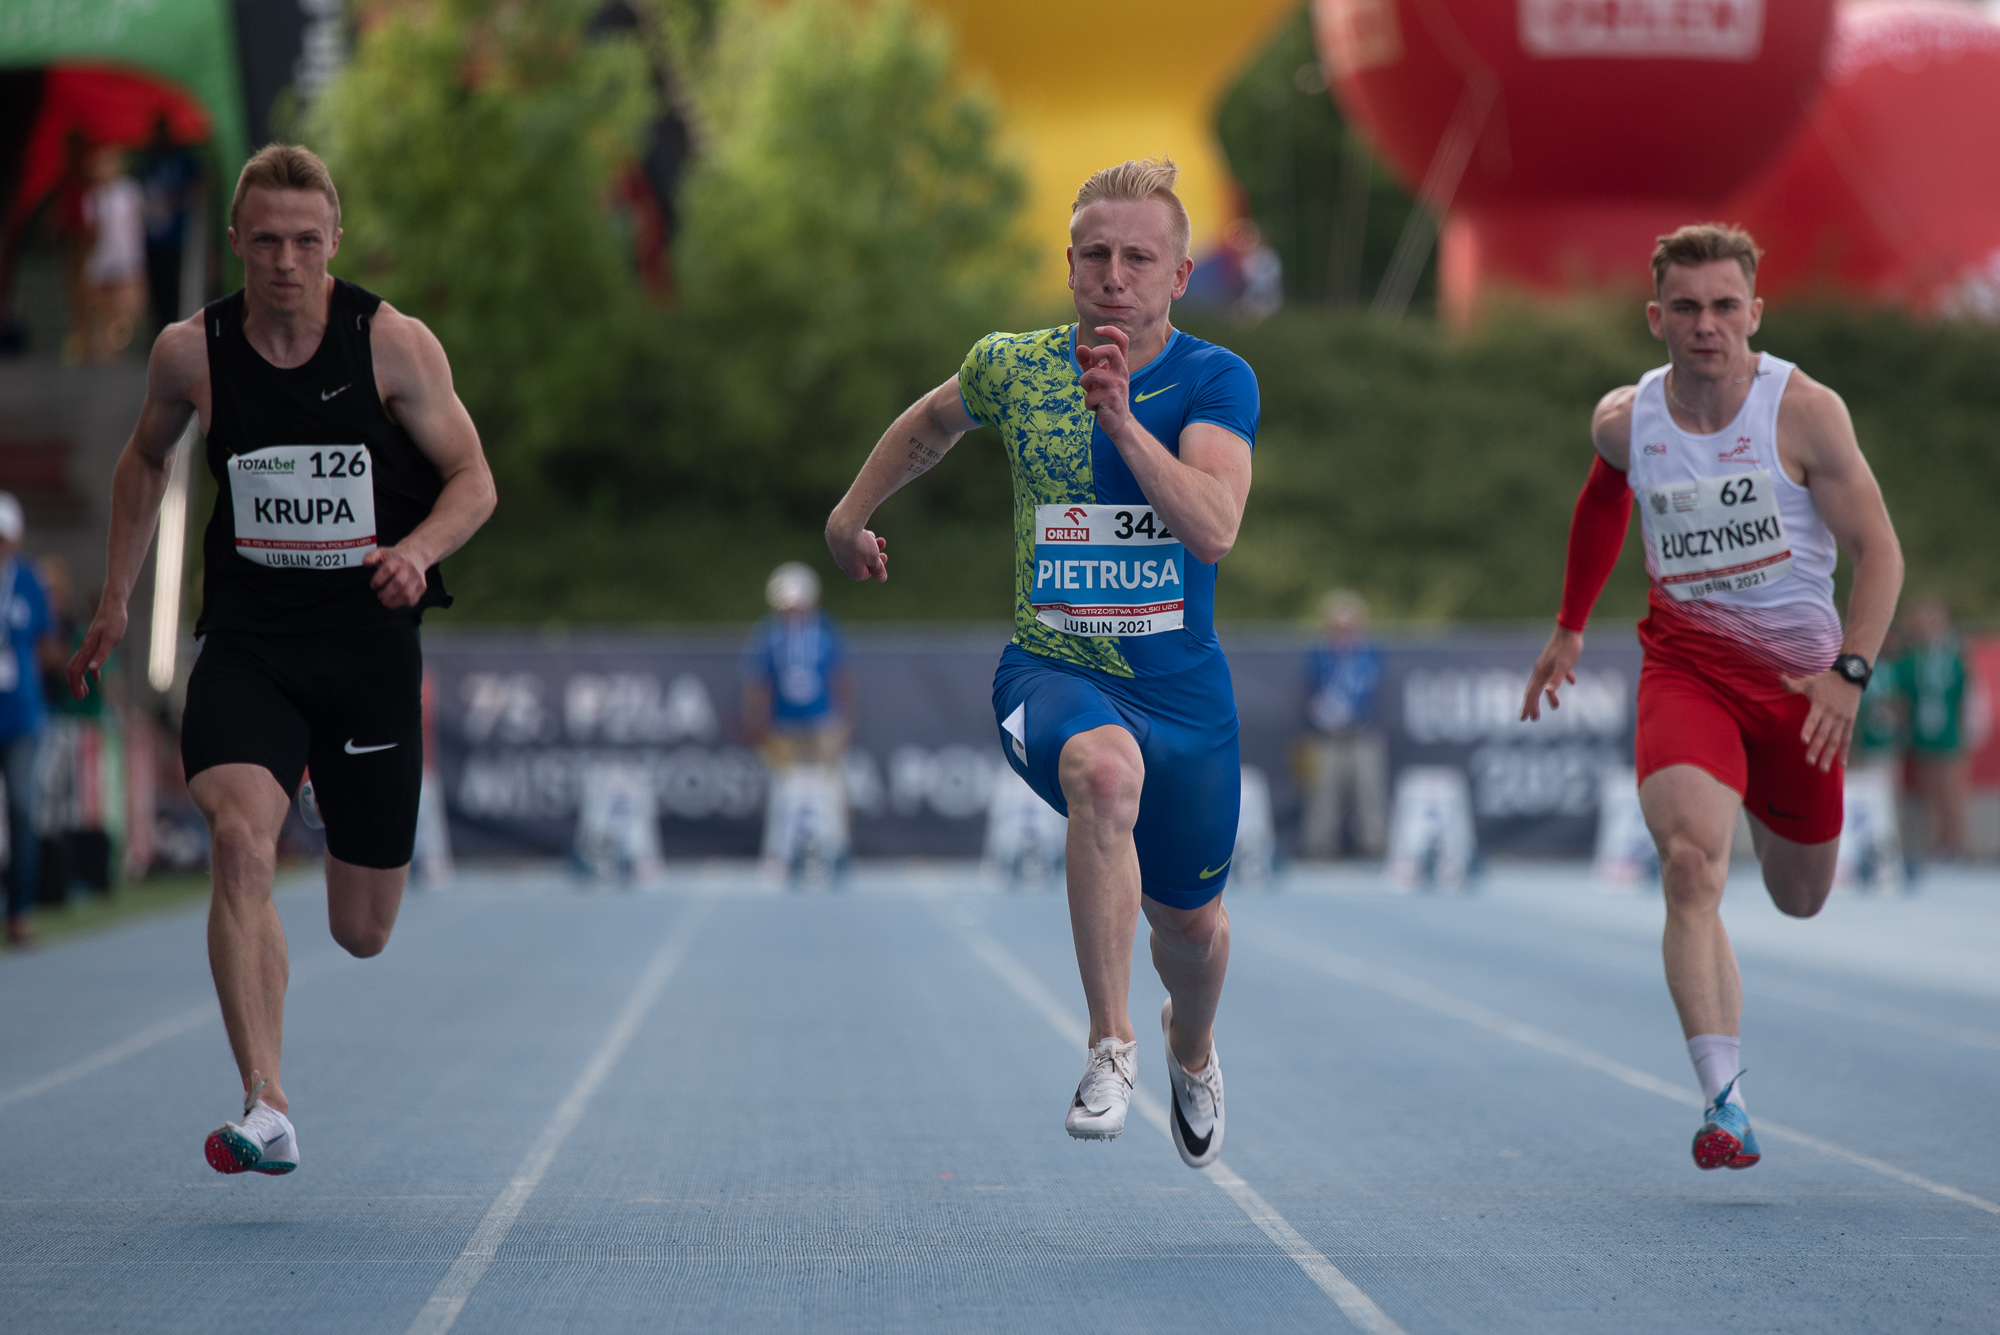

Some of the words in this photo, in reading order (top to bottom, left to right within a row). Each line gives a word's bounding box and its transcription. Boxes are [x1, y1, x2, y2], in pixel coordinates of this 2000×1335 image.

[908, 436, 945, 460] FRIEN
[309, 451, 366, 479] 126
[1720, 478, 1757, 507] 62
[254, 497, 356, 525] KRUPA
[1046, 529, 1088, 540] ORLEN
[1661, 515, 1781, 560] ŁUCZYŃSKI
[266, 553, 310, 566] LUBLIN
[315, 553, 348, 567] 2021
[1036, 558, 1181, 590] PIETRUSA
[1689, 578, 1732, 598] LUBLIN
[1736, 571, 1767, 590] 2021
[1133, 606, 1161, 614] POLSKI
[1064, 618, 1112, 634] LUBLIN
[1118, 620, 1152, 634] 2021
